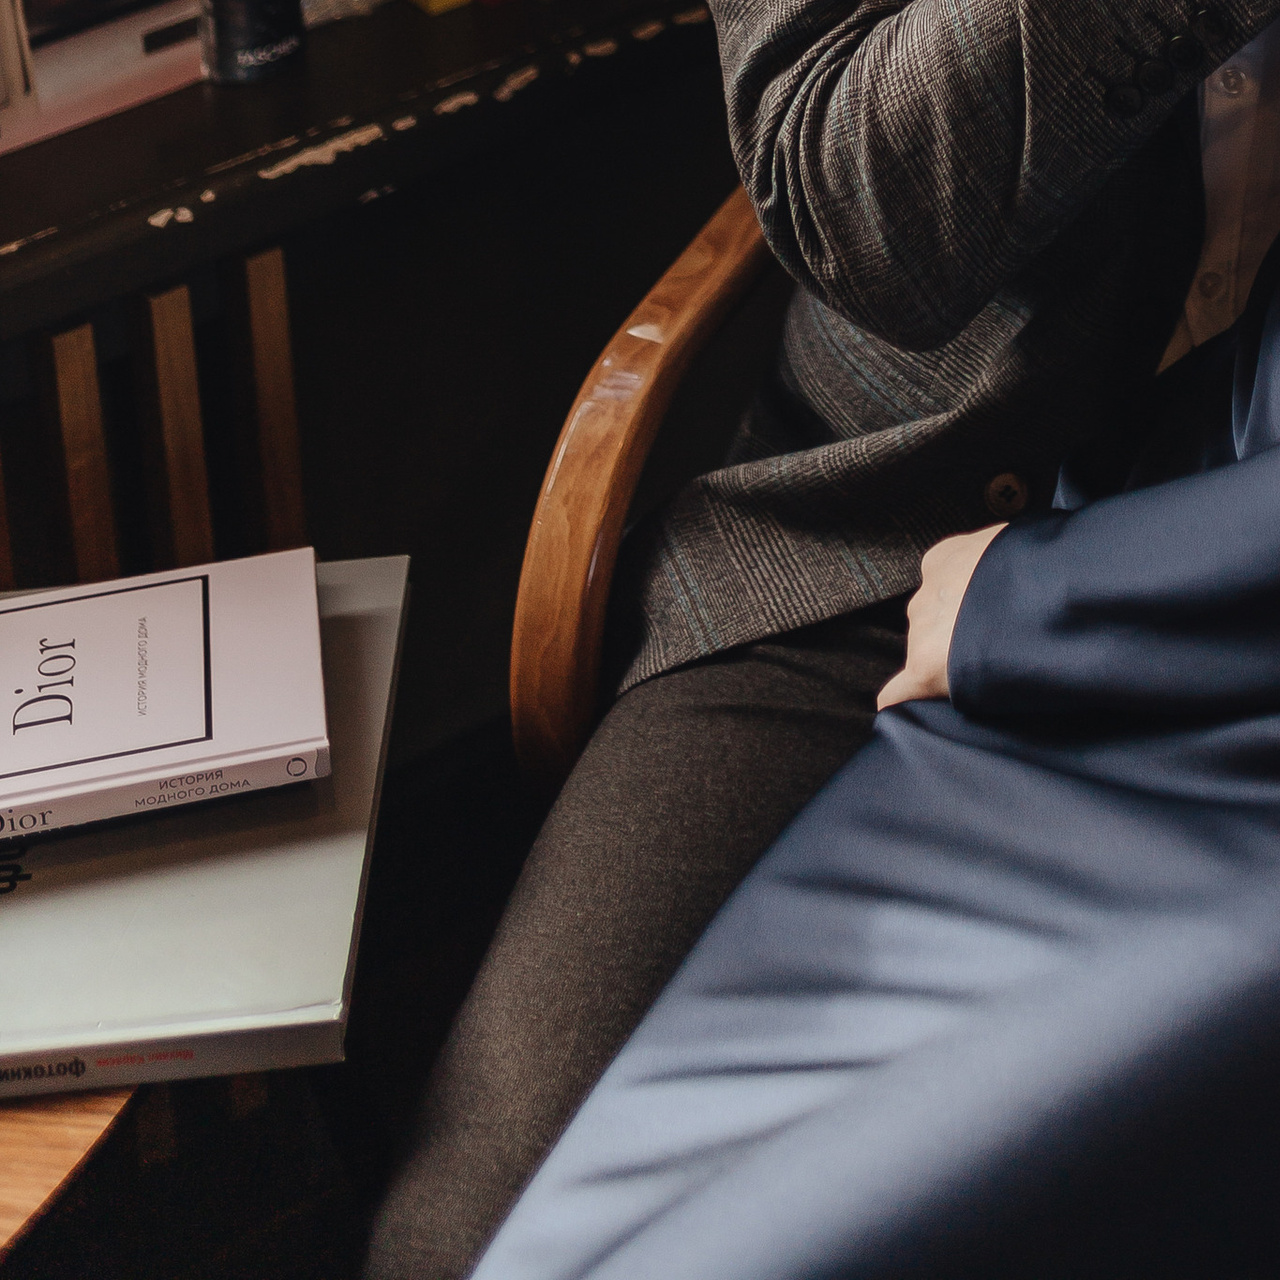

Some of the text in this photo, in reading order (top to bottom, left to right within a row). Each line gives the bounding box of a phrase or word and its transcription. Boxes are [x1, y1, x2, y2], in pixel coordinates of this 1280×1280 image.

[13, 637, 76, 736] Dior
[137, 616, 148, 717] ИСТОРИЯ МОДНОГО ДОМА
[135, 778, 250, 808] МОДНОГО ДОМА
[159, 770, 223, 790] ИСТОРИЯ
